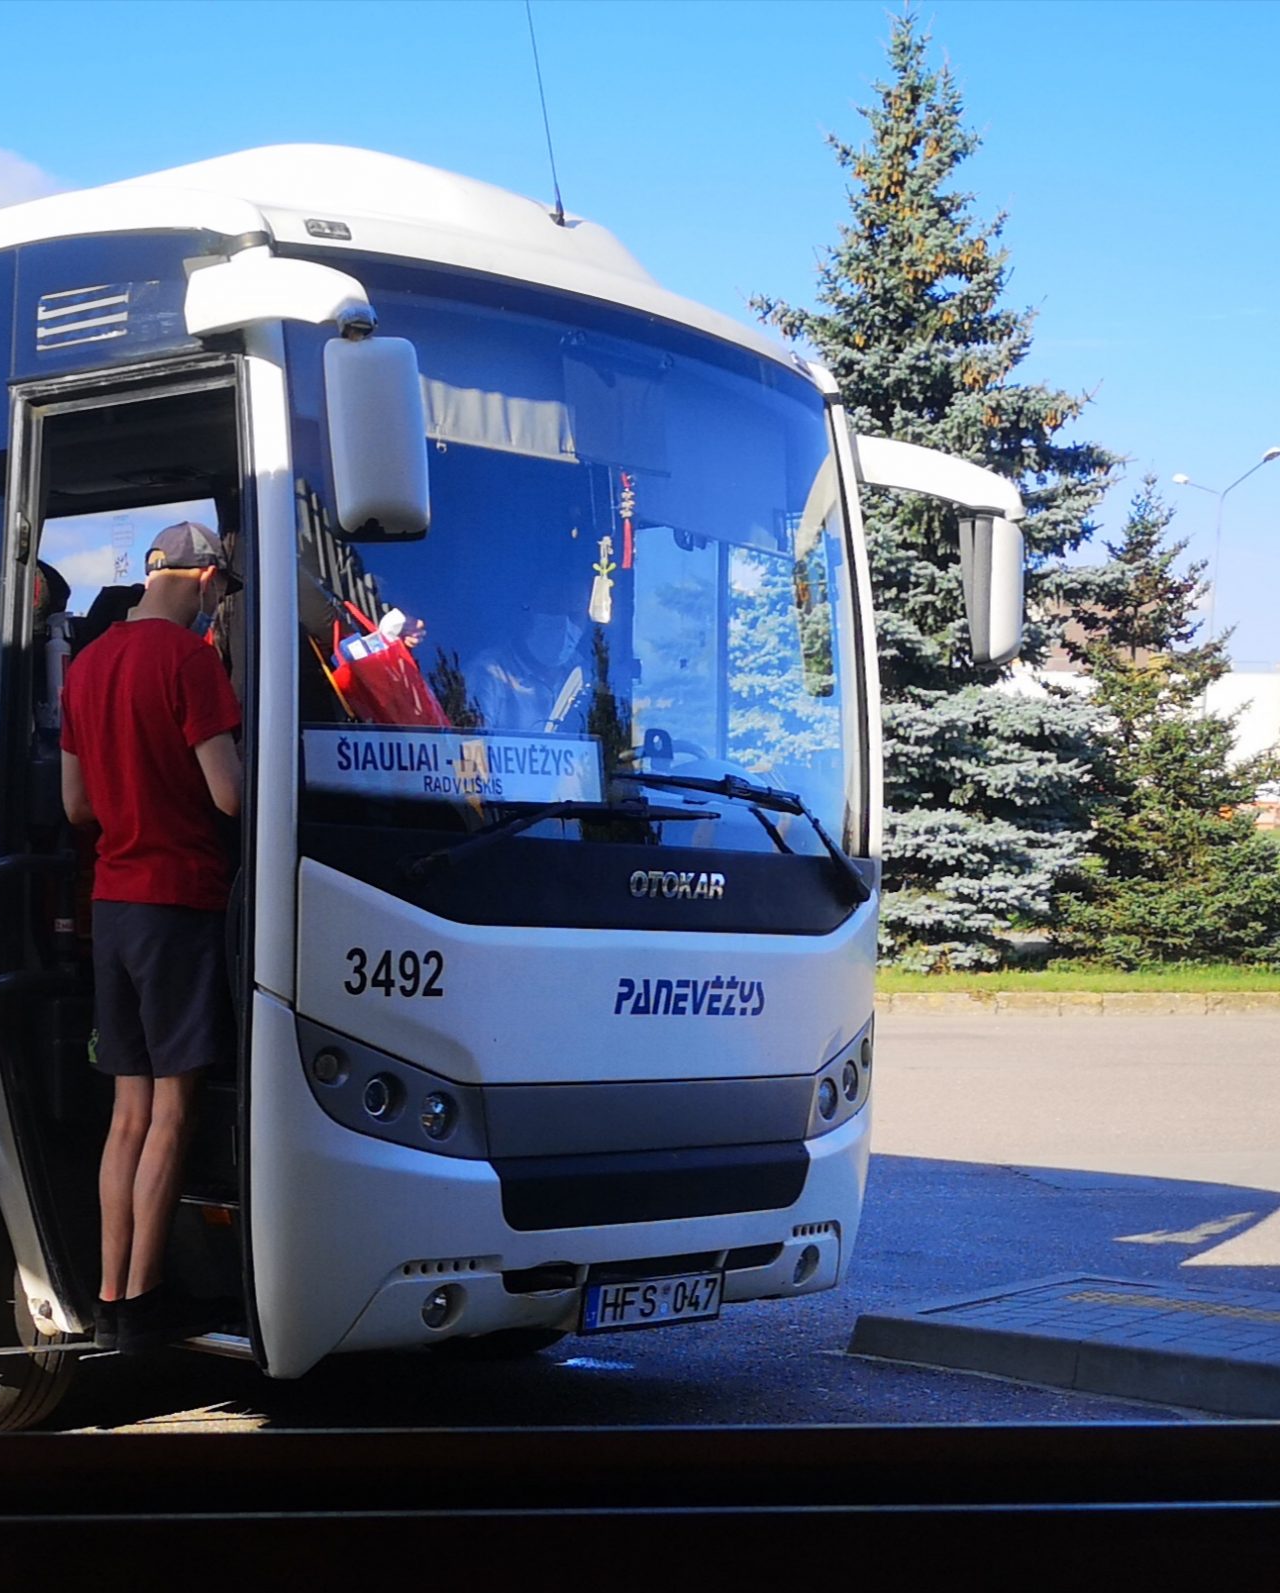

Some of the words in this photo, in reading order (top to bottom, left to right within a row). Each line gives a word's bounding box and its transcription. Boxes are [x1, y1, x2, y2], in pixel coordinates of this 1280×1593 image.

[337, 737, 438, 772] ŠIAULIAI
[423, 774, 503, 795] RADVLIŠKIS
[630, 870, 725, 899] OTOKAR
[344, 947, 443, 997] 3492
[614, 975, 765, 1016] PANEVĖŽYS
[600, 1285, 657, 1322] HFS
[673, 1278, 718, 1313] 047
